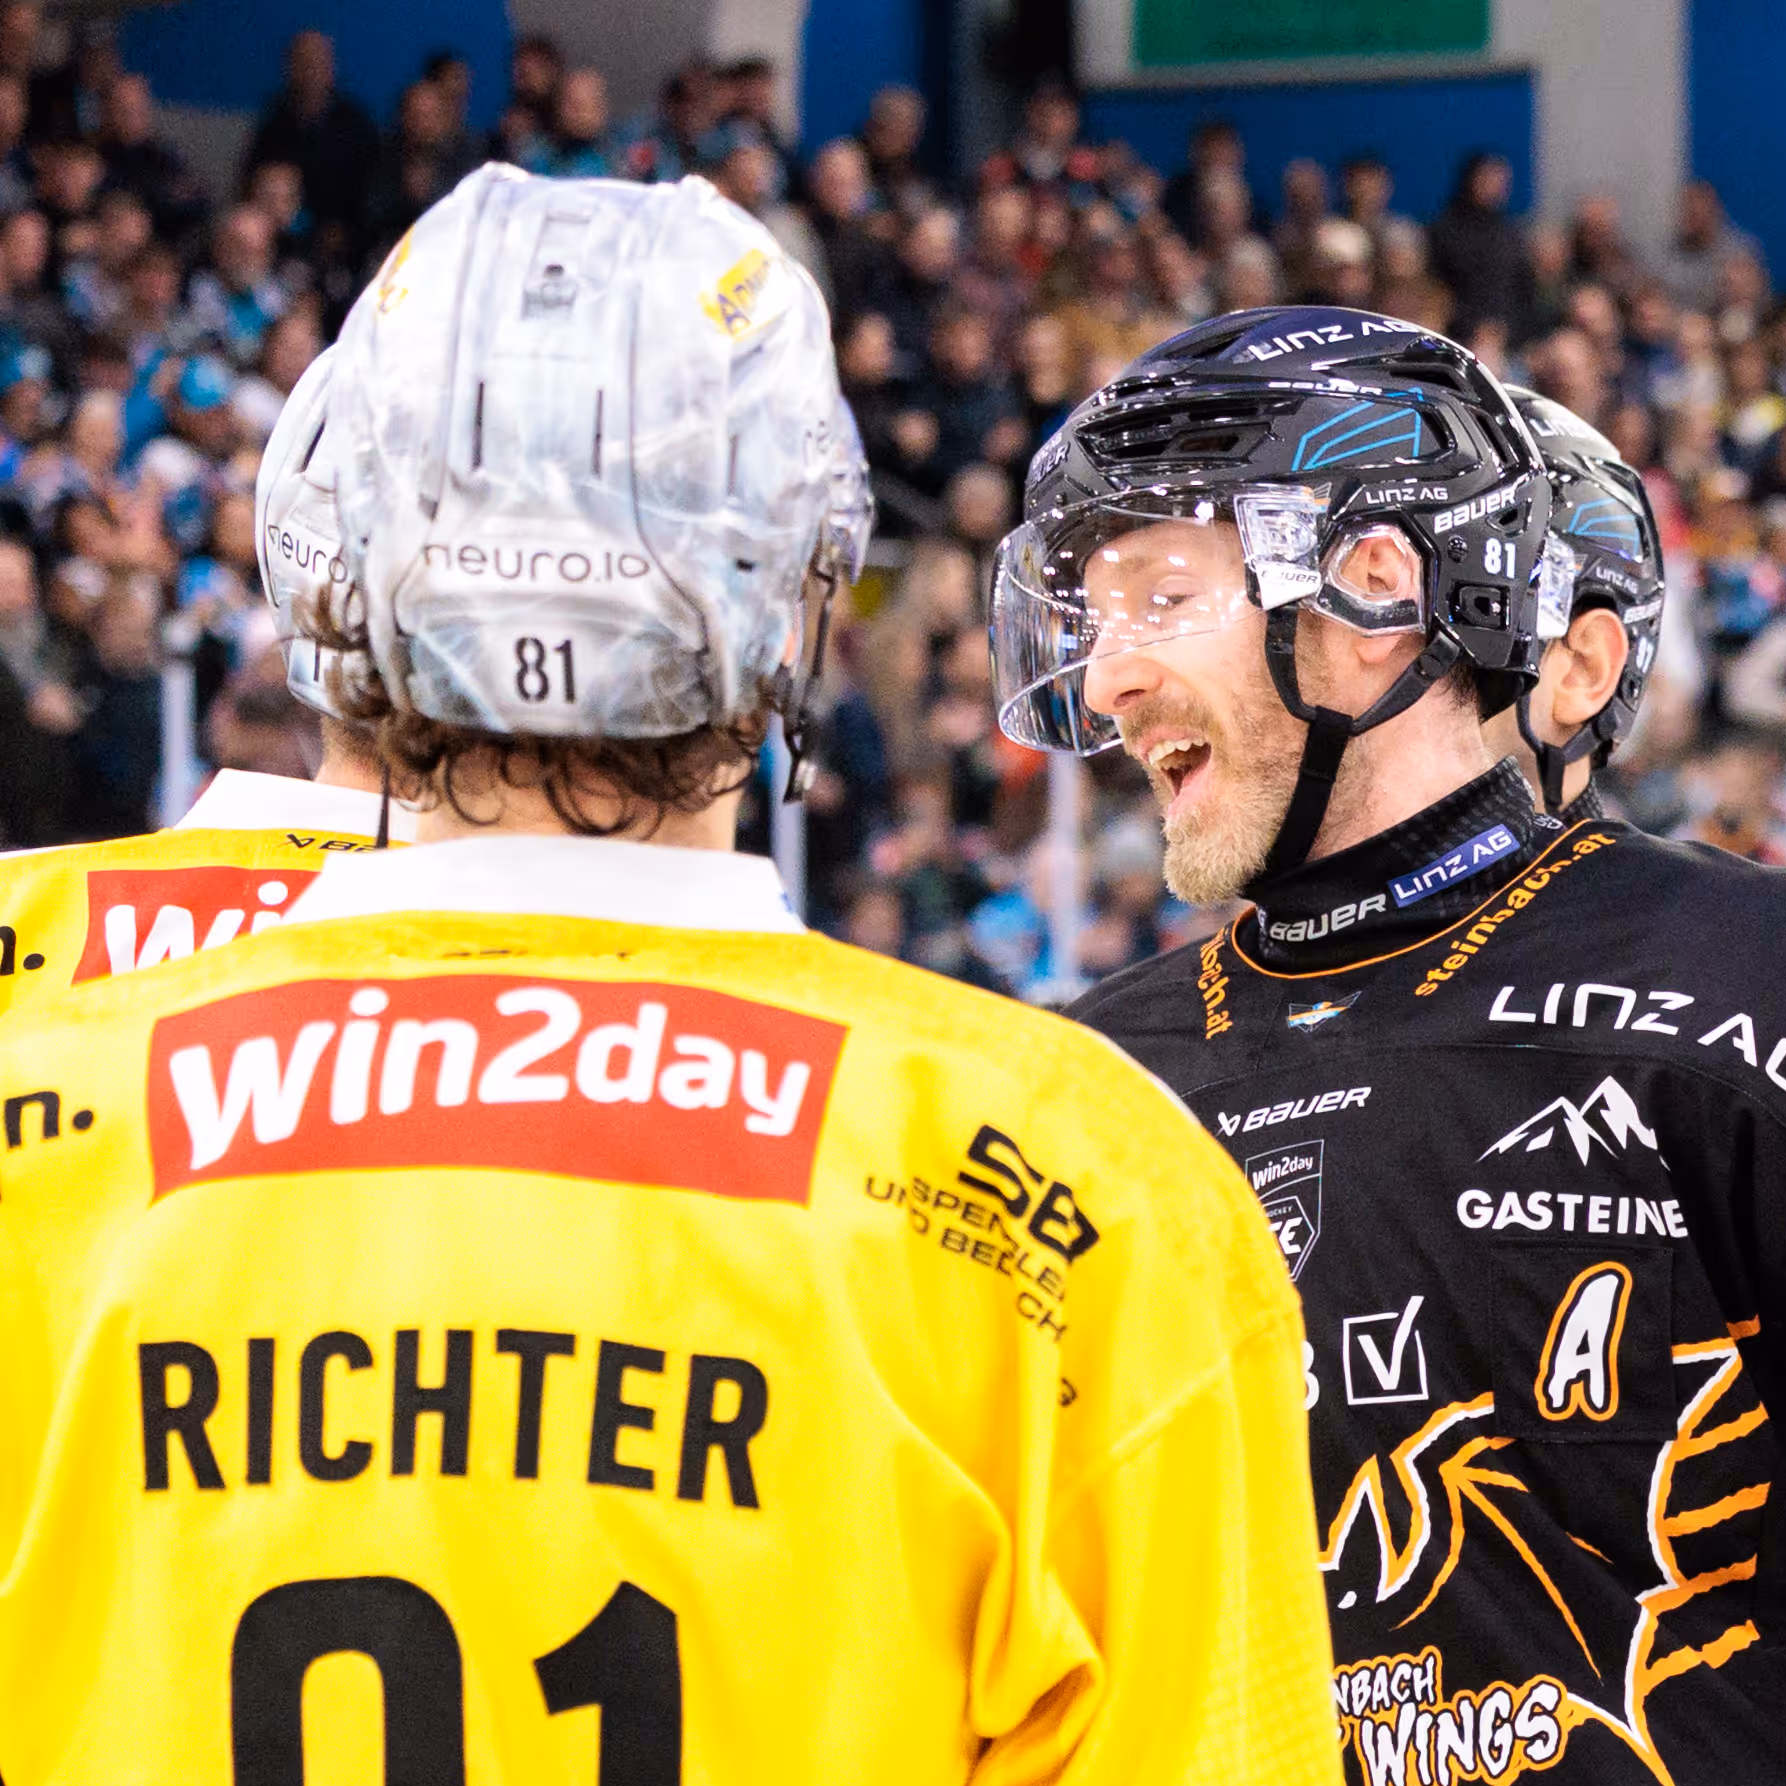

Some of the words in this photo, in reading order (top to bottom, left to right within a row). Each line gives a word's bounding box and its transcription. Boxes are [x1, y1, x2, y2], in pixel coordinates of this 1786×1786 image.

[1248, 324, 1353, 361] LINZ
[1365, 486, 1414, 504] LINZ
[1419, 486, 1448, 501] AG
[1434, 485, 1516, 533] BAUER
[1484, 538, 1517, 579] 81
[515, 636, 576, 704] 81
[1394, 858, 1468, 900] LINZ
[1472, 830, 1512, 864] AG
[1270, 893, 1387, 942] BAUER
[1414, 832, 1616, 996] steinbach.at
[1489, 983, 1695, 1036] LINZ
[170, 987, 811, 1170] win2day
[1242, 1086, 1372, 1132] BAUER
[1252, 1156, 1314, 1191] win2day
[1543, 1267, 1628, 1415] A
[138, 1328, 769, 1510] RICHTER
